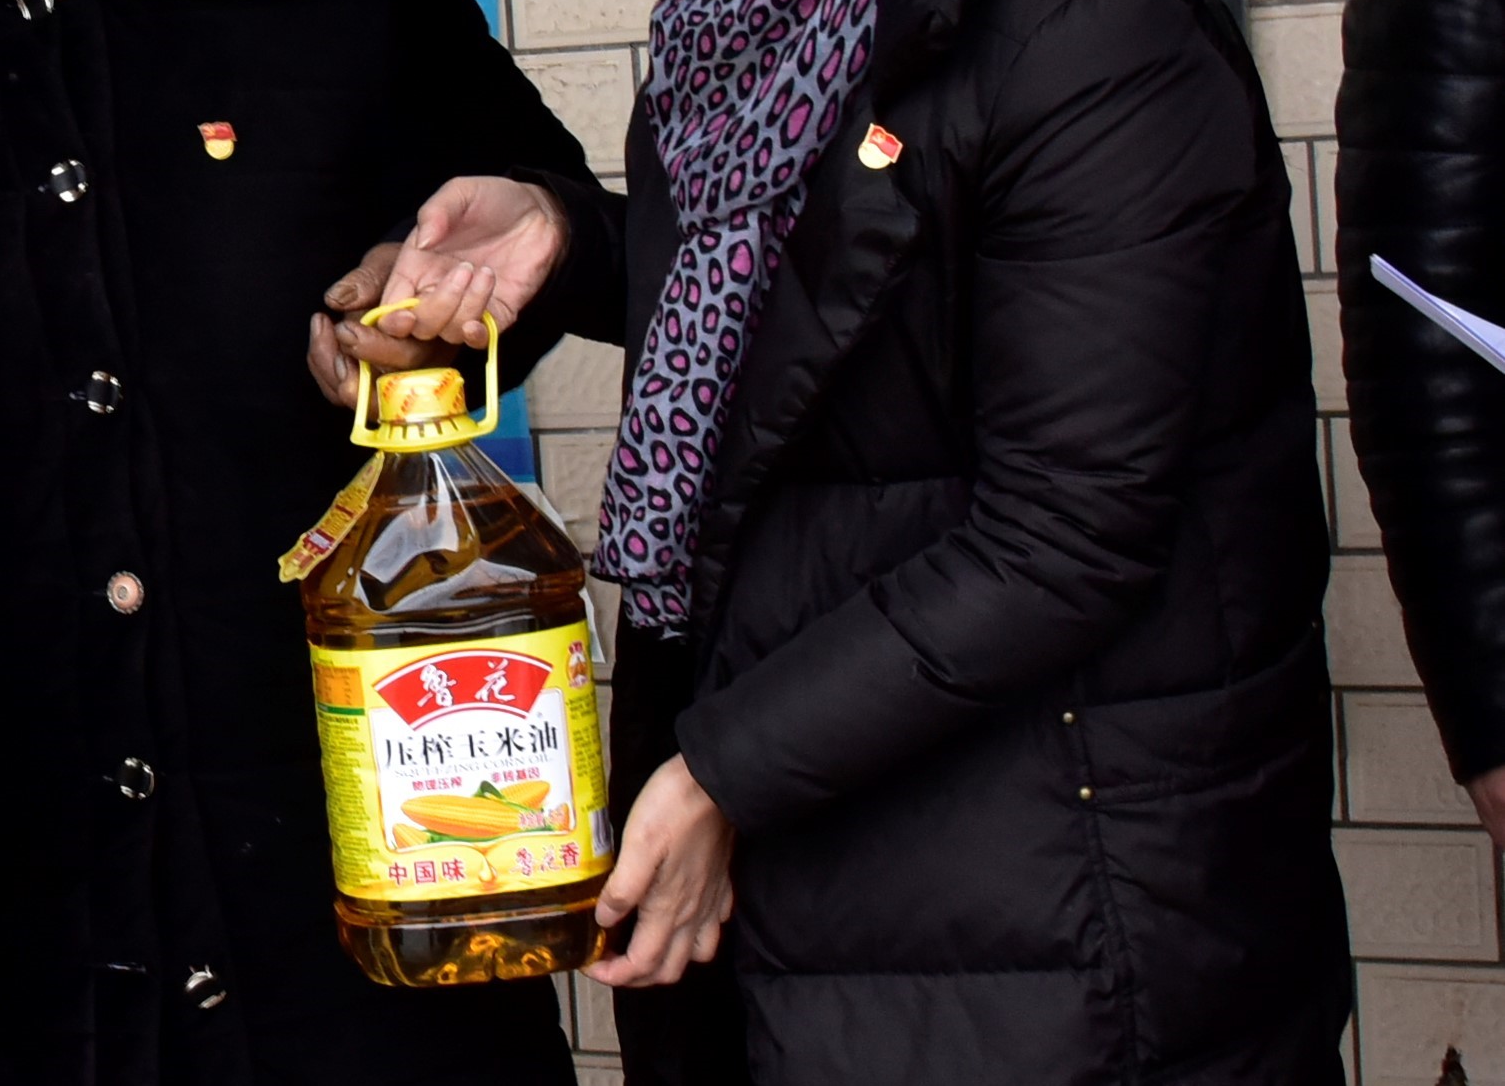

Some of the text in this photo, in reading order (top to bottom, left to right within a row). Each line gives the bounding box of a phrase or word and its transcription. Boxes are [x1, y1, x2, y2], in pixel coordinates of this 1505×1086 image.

[417, 658, 516, 707] 鲁花
[385, 721, 558, 768] 压榨玉米油
[388, 858, 466, 886] 中国味
